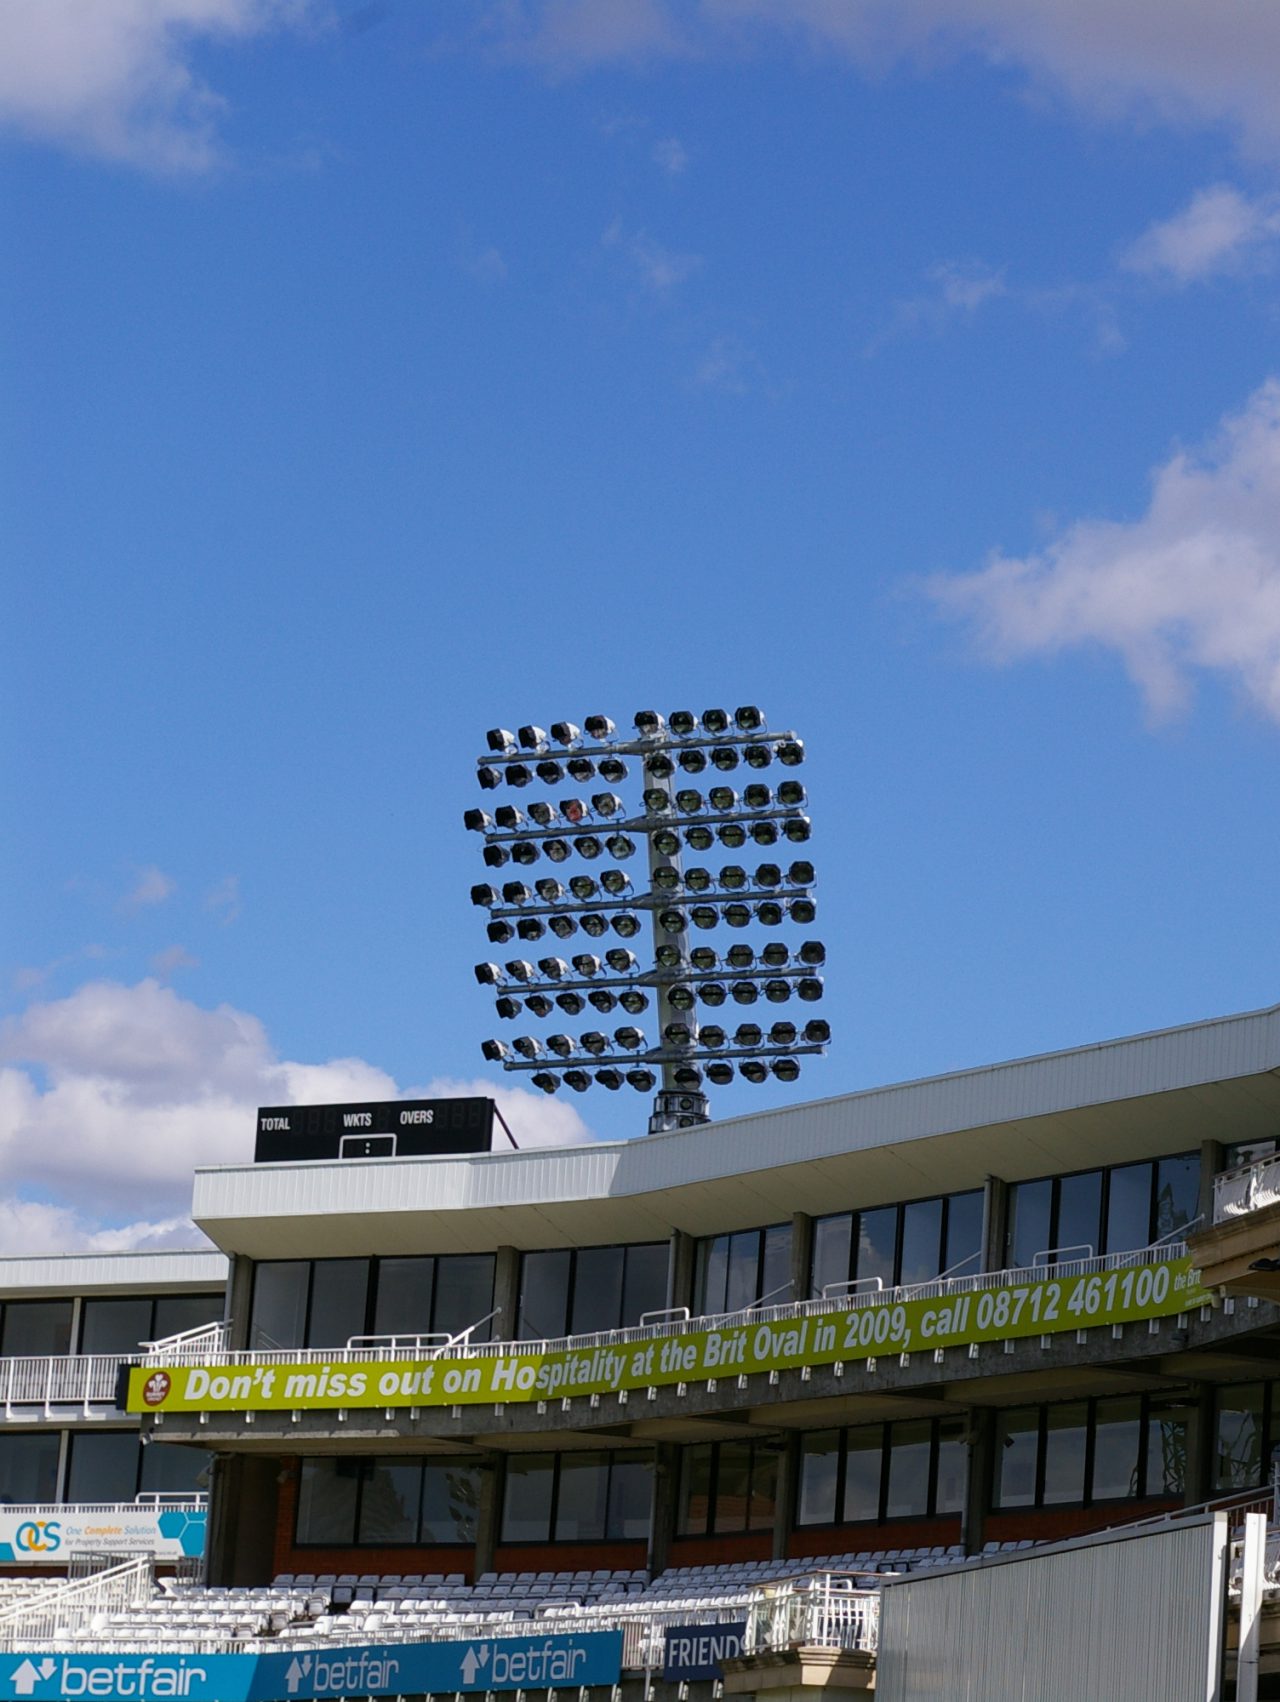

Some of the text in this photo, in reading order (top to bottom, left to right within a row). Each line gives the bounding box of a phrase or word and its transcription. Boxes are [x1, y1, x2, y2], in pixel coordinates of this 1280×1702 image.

[260, 1117, 291, 1131] TOTAL
[343, 1112, 372, 1127] WKTS
[400, 1109, 433, 1125] OVERS
[184, 1265, 1170, 1400] Don't miss out on Hospitality at the Brit Oval in 2009, call 08712 461100
[16, 1521, 62, 1552] OCS
[66, 1525, 156, 1537] One Complete Solution
[65, 1538, 154, 1548] for Property Support Services
[312, 1651, 399, 1692] betfair
[491, 1639, 587, 1683] betfair
[60, 1658, 207, 1696] betfair
